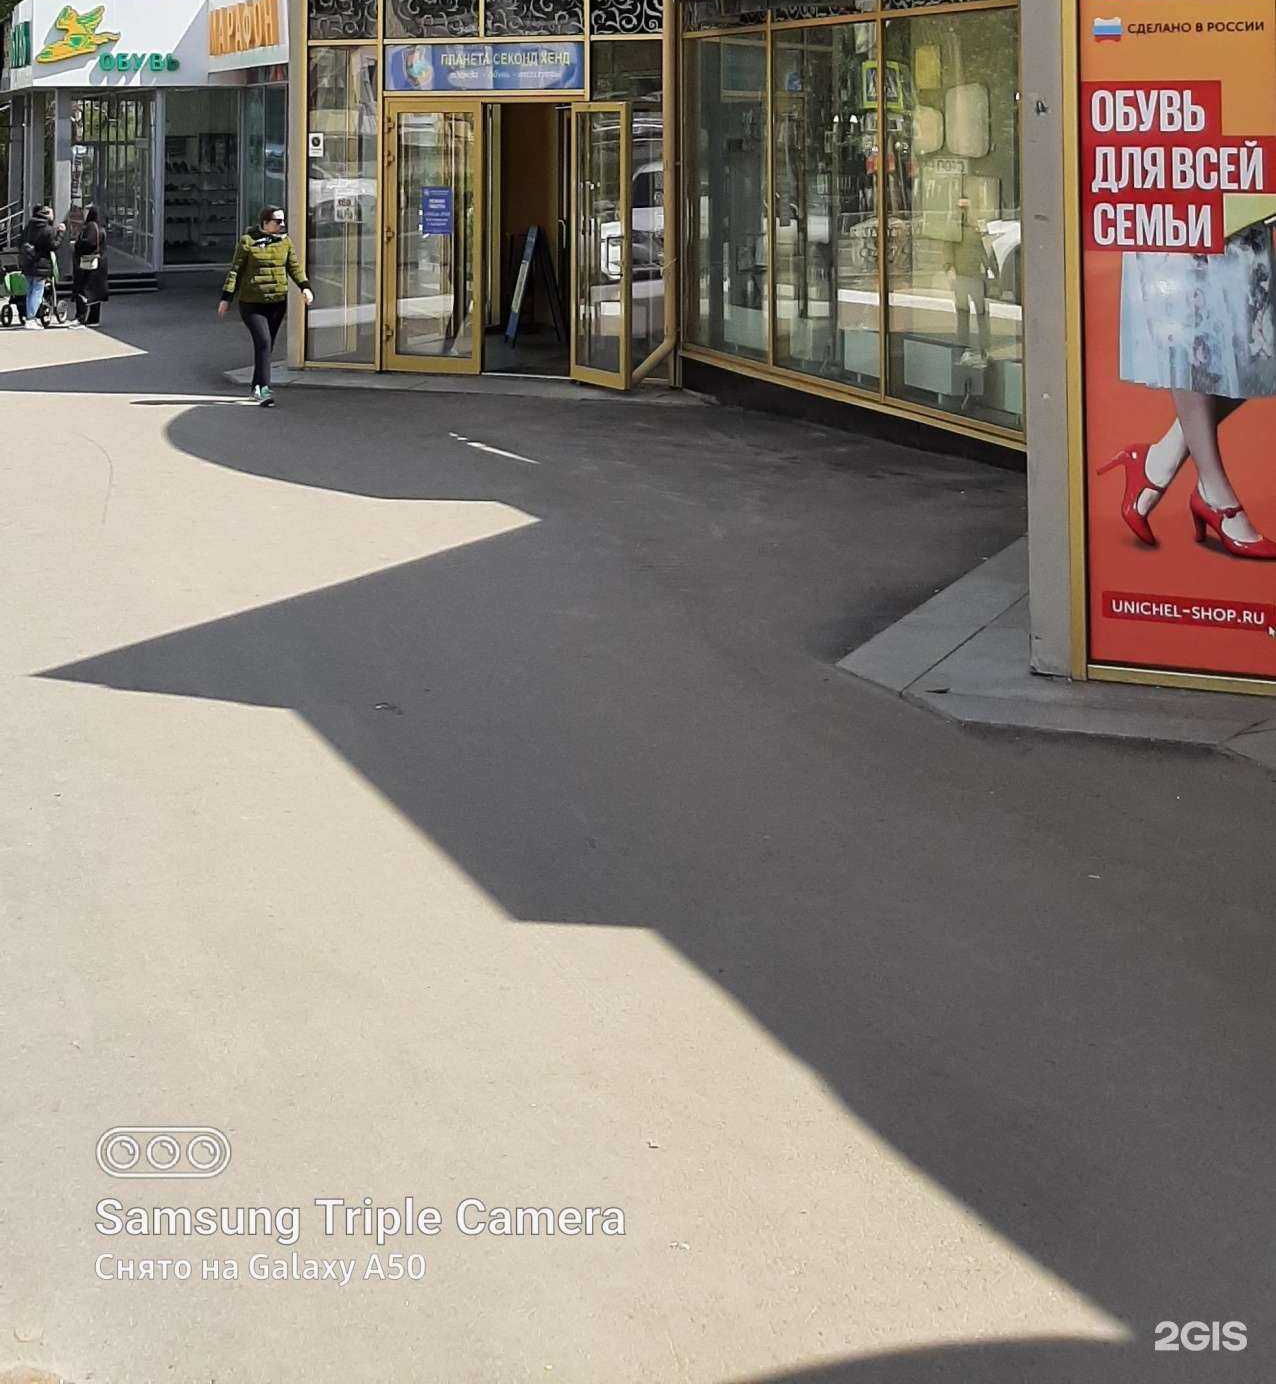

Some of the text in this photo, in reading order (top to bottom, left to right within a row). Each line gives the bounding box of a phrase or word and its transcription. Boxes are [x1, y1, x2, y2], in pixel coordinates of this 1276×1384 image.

[1127, 21, 1265, 35] СДЕЛАНО В РОССИИ
[99, 52, 180, 72] ОБУВЬ
[440, 50, 570, 66] ПЛАНЕТА СЕКОНД ХЕНД
[1091, 89, 1206, 133] ОБУВЬ
[1092, 140, 1264, 193] ДЛЯ ВСЕЙ
[1094, 203, 1212, 248] СЕМЬИ
[1111, 599, 1265, 625] UNICHEL-SHOP.RU
